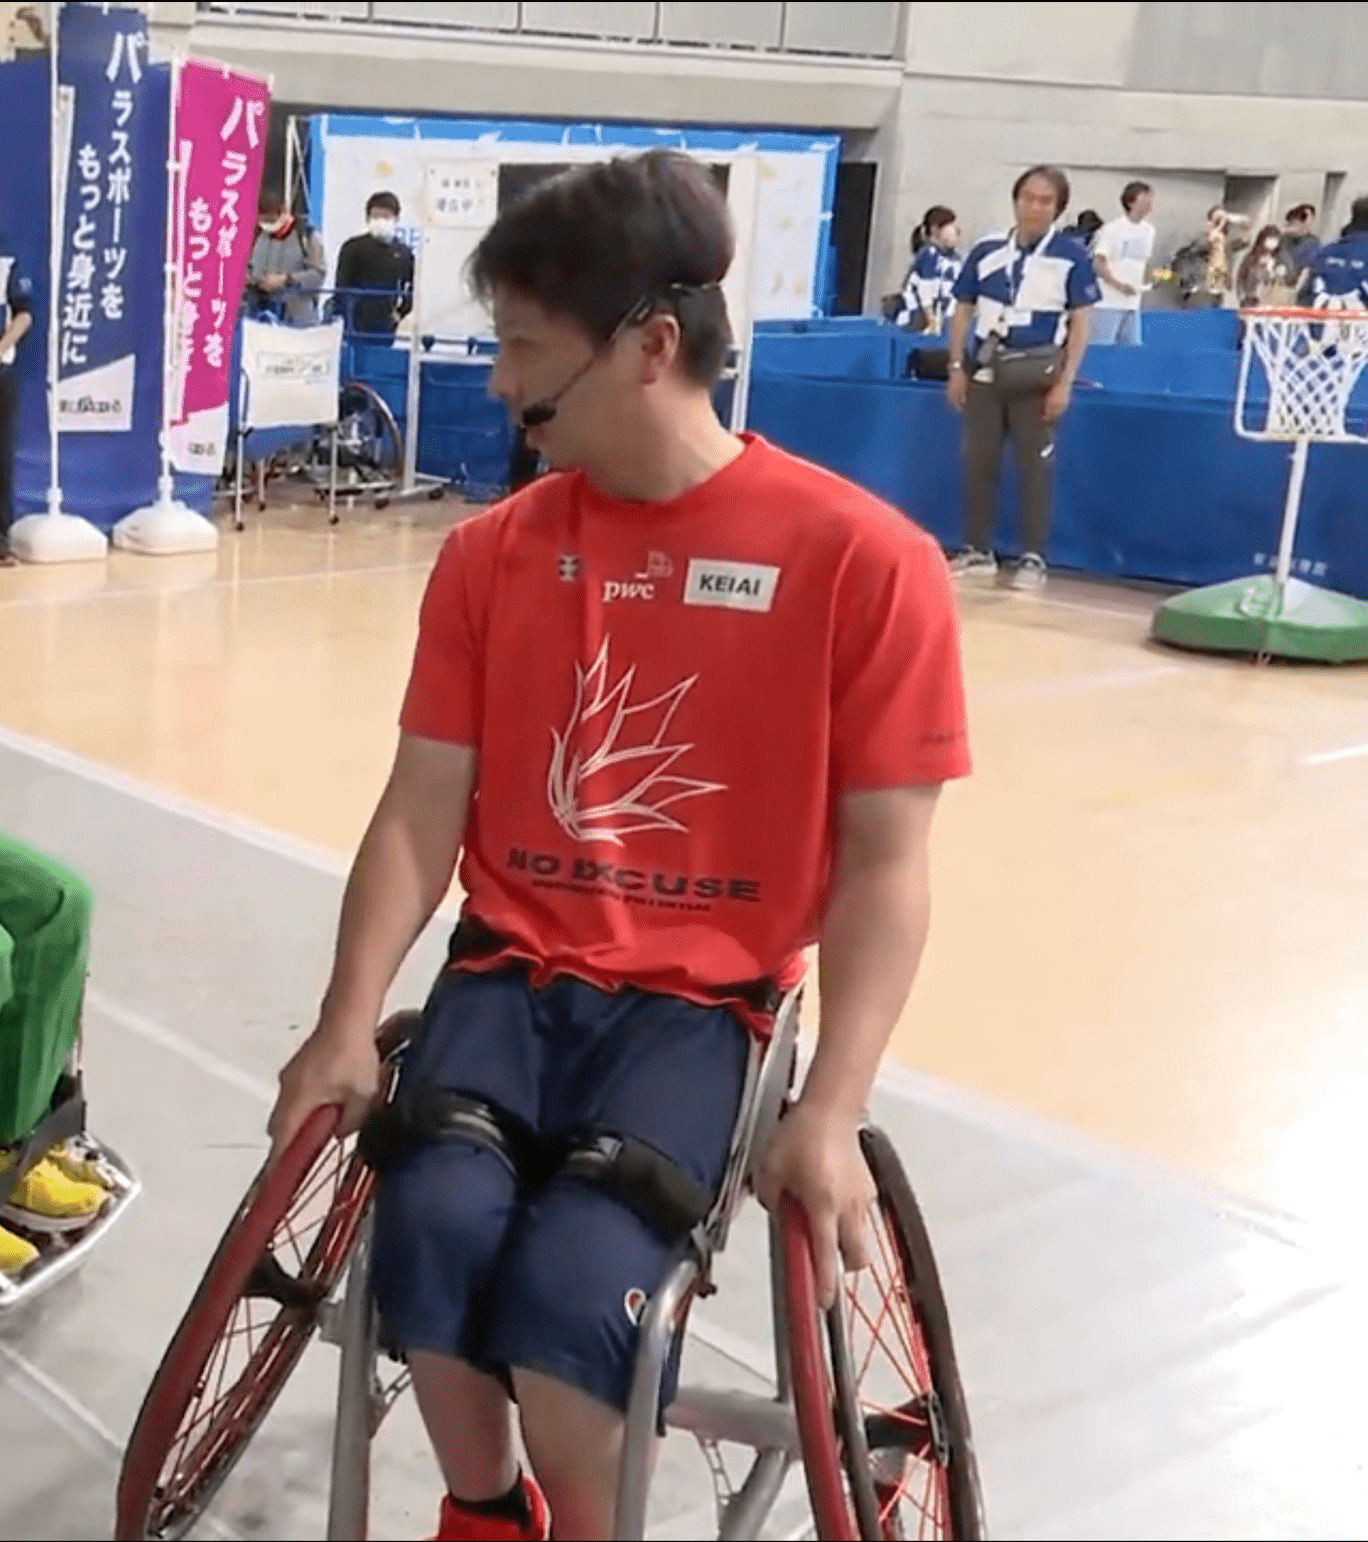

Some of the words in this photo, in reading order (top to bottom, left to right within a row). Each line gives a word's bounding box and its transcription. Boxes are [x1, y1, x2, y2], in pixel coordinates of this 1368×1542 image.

[99, 31, 145, 320] パラスポーツを
[61, 142, 101, 366] もっと身近に
[601, 579, 656, 603] pwc
[698, 573, 762, 597] KEIAI
[507, 847, 561, 877] NO
